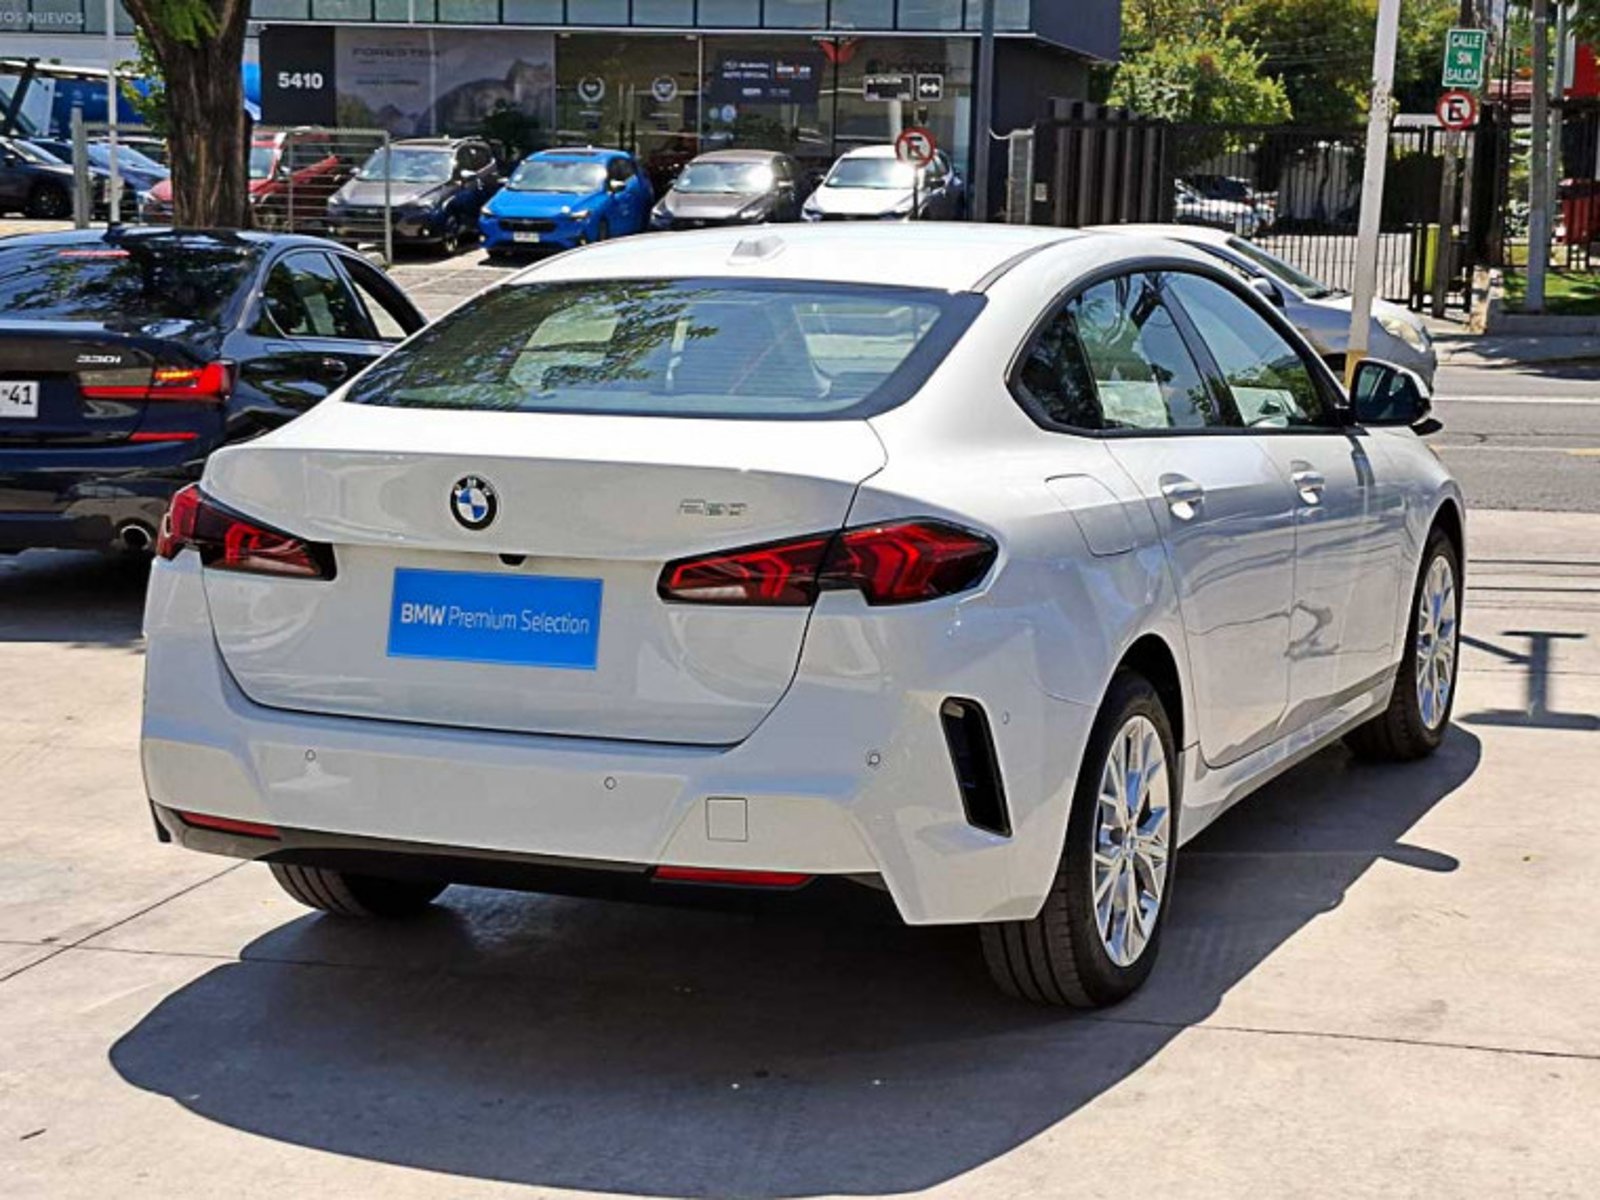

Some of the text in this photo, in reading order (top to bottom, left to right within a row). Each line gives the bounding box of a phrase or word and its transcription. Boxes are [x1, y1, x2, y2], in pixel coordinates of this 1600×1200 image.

[26, 11, 84, 24] NUEVOS
[1452, 33, 1482, 49] CALLE
[1456, 51, 1473, 65] SIN
[277, 71, 324, 90] 5410
[1446, 68, 1479, 81] SALIDA
[401, 602, 590, 635] BMW Premium Selection
